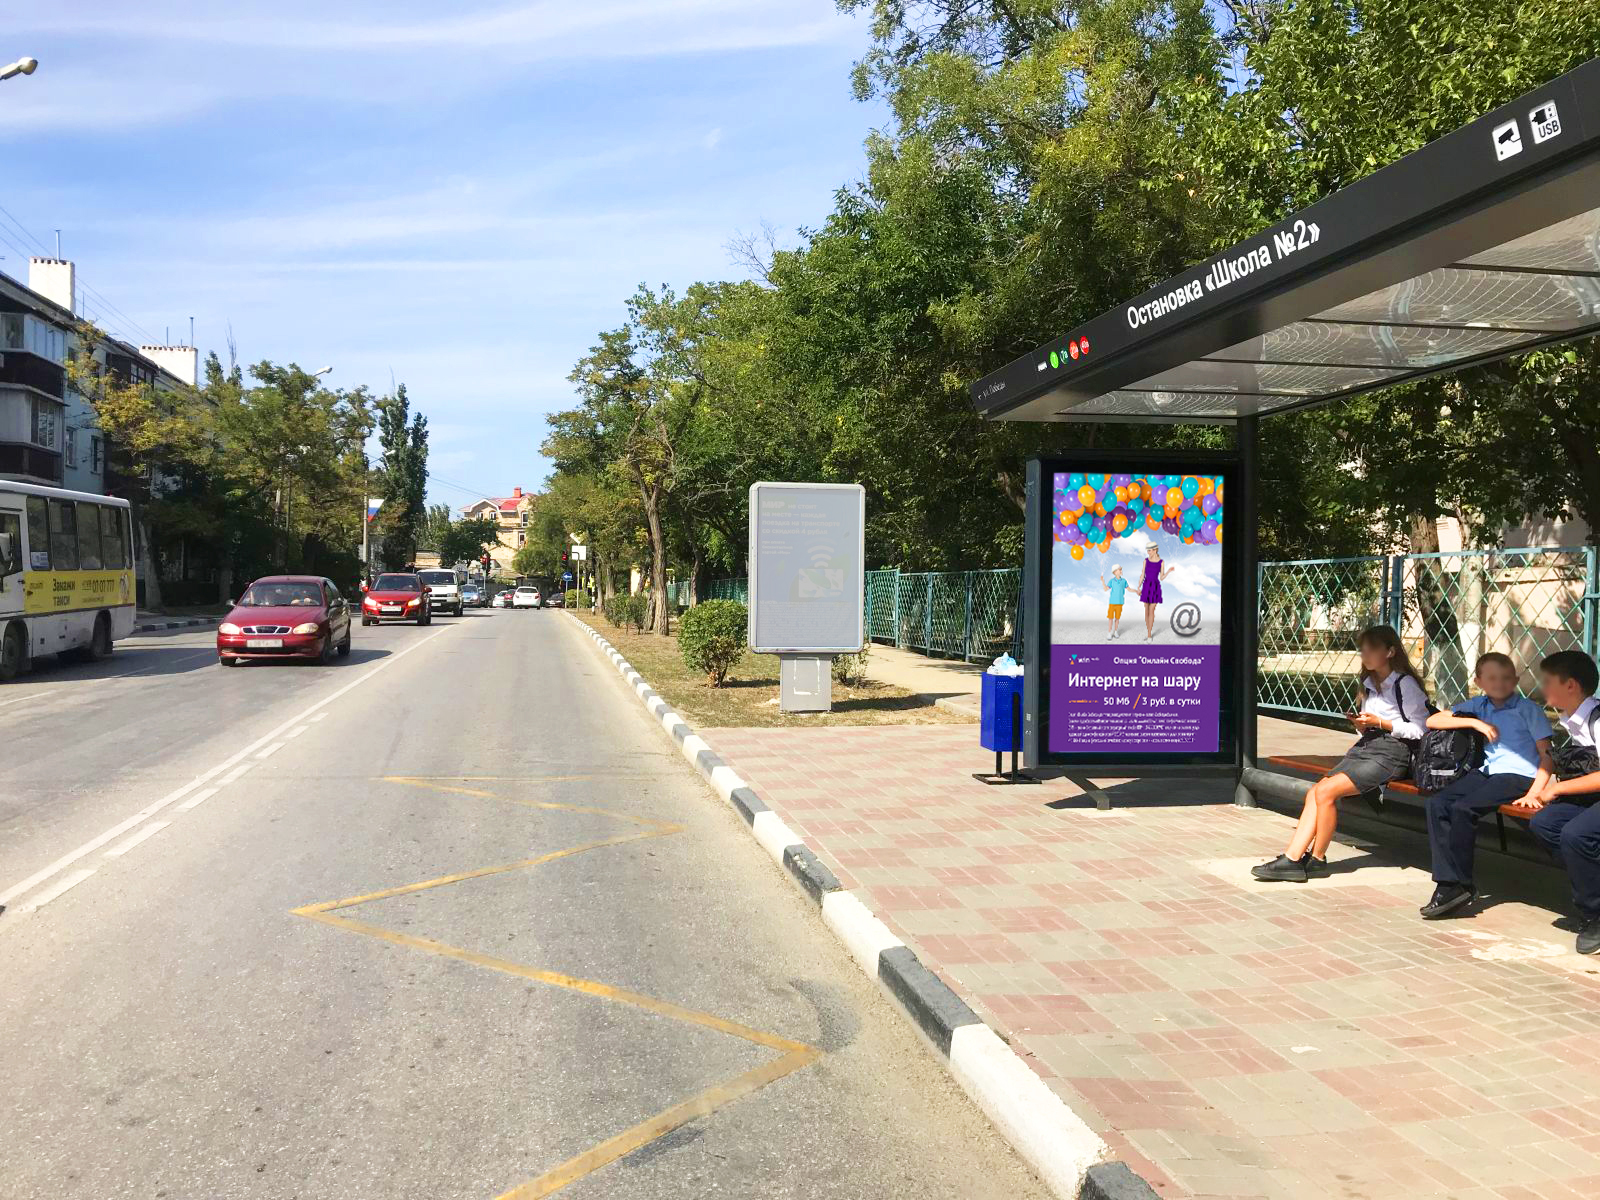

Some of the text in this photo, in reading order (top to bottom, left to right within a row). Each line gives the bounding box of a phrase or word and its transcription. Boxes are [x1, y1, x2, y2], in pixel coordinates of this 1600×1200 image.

[1538, 120, 1560, 138] USB
[1127, 219, 1320, 329] Остановка «Школа №2»
[761, 501, 785, 509] МИР
[771, 527, 800, 535] скидкой
[1113, 656, 1205, 665] Опция "Онлайн Свобода"
[1068, 672, 1201, 691] Интернет на шару
[1103, 697, 1115, 705] 50
[1116, 696, 1130, 706] Мб
[1142, 697, 1148, 706] 3
[1150, 696, 1168, 708] руб.
[1169, 698, 1175, 706] в
[1177, 698, 1201, 708] сутки
